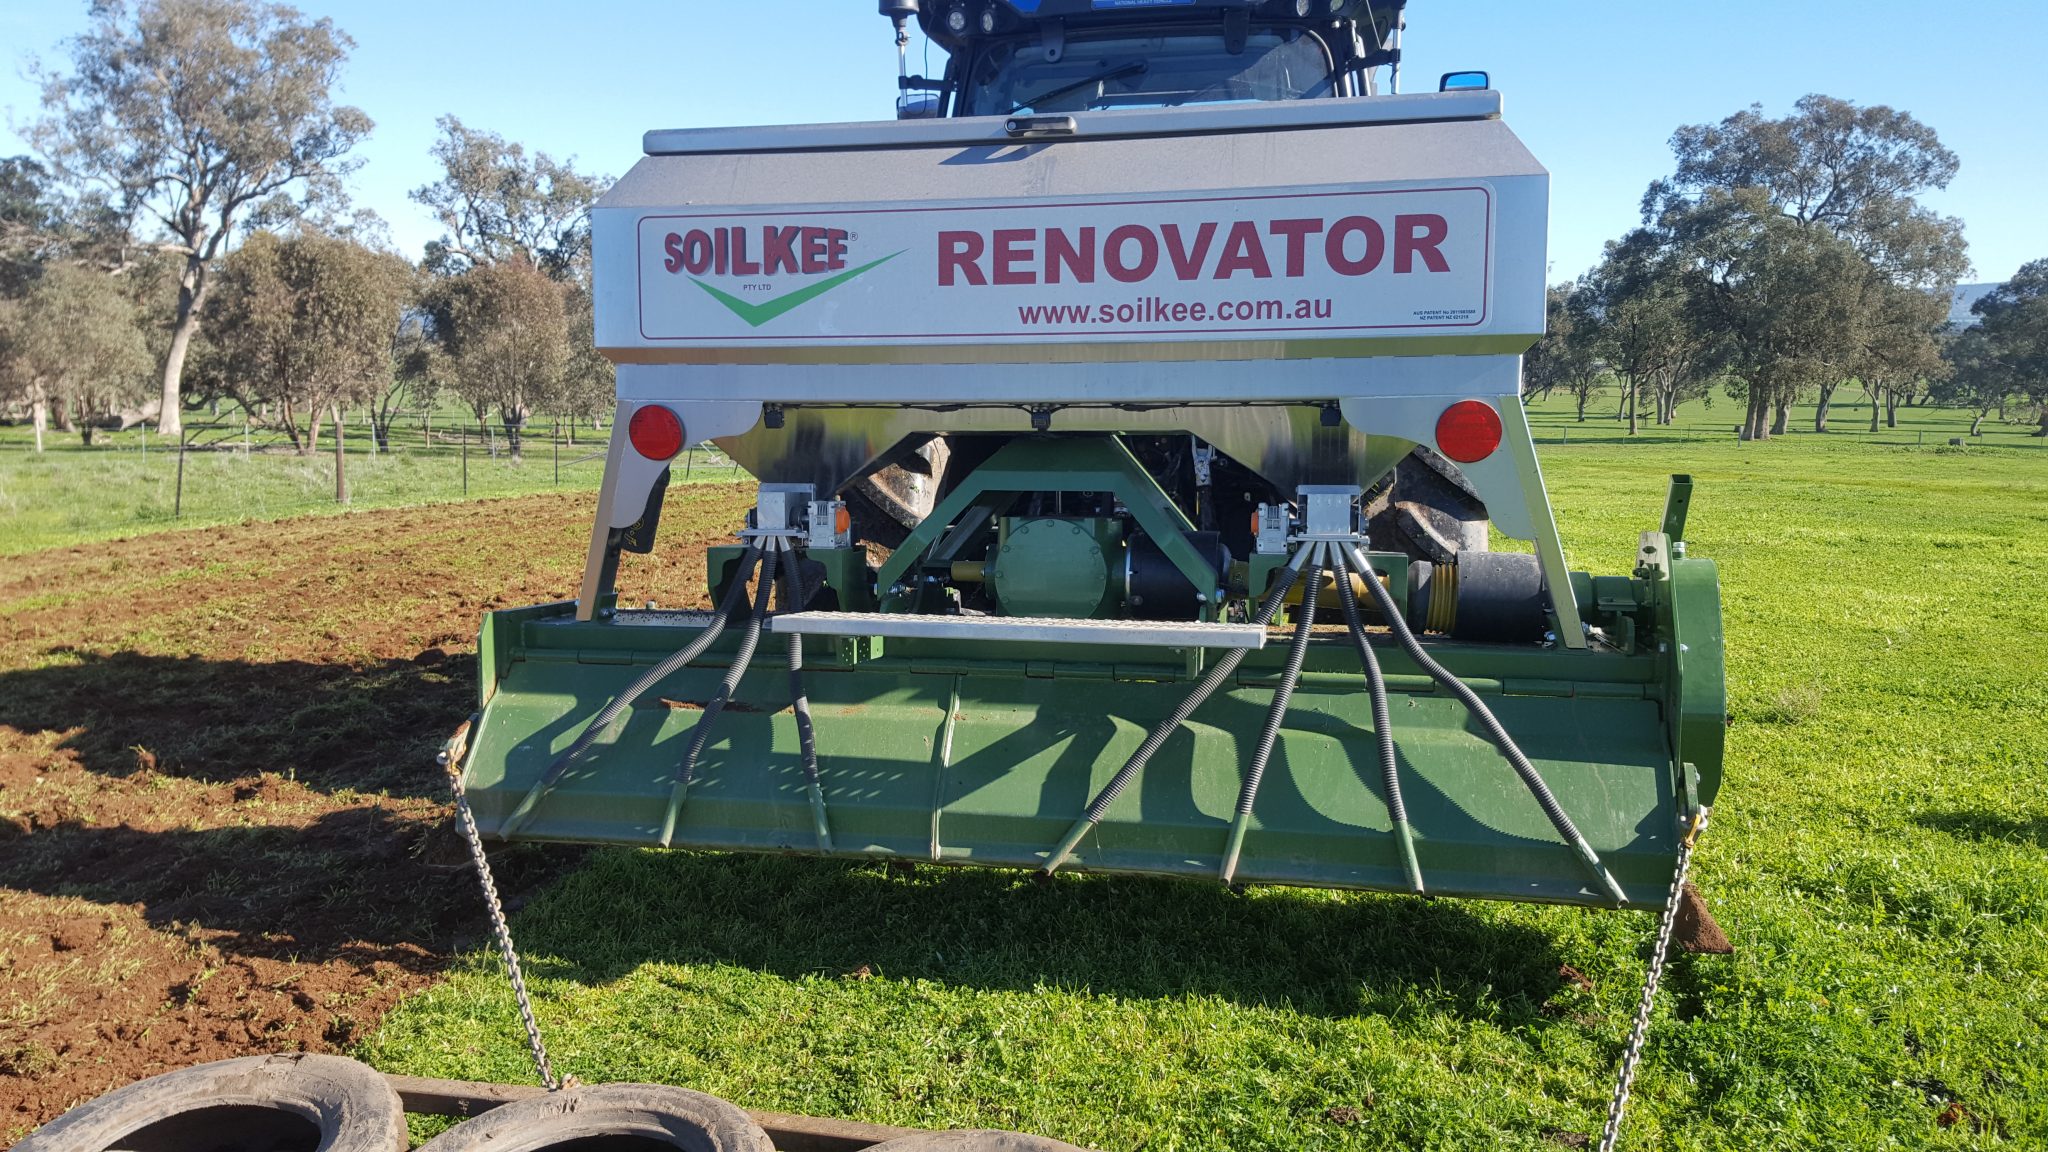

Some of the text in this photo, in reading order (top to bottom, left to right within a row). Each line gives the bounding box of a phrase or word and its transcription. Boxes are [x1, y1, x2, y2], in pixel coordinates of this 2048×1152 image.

[938, 213, 1450, 287] RENOVATOR
[743, 283, 772, 291] PTY LTD
[1018, 298, 1333, 325] www.soilkee.com.au
